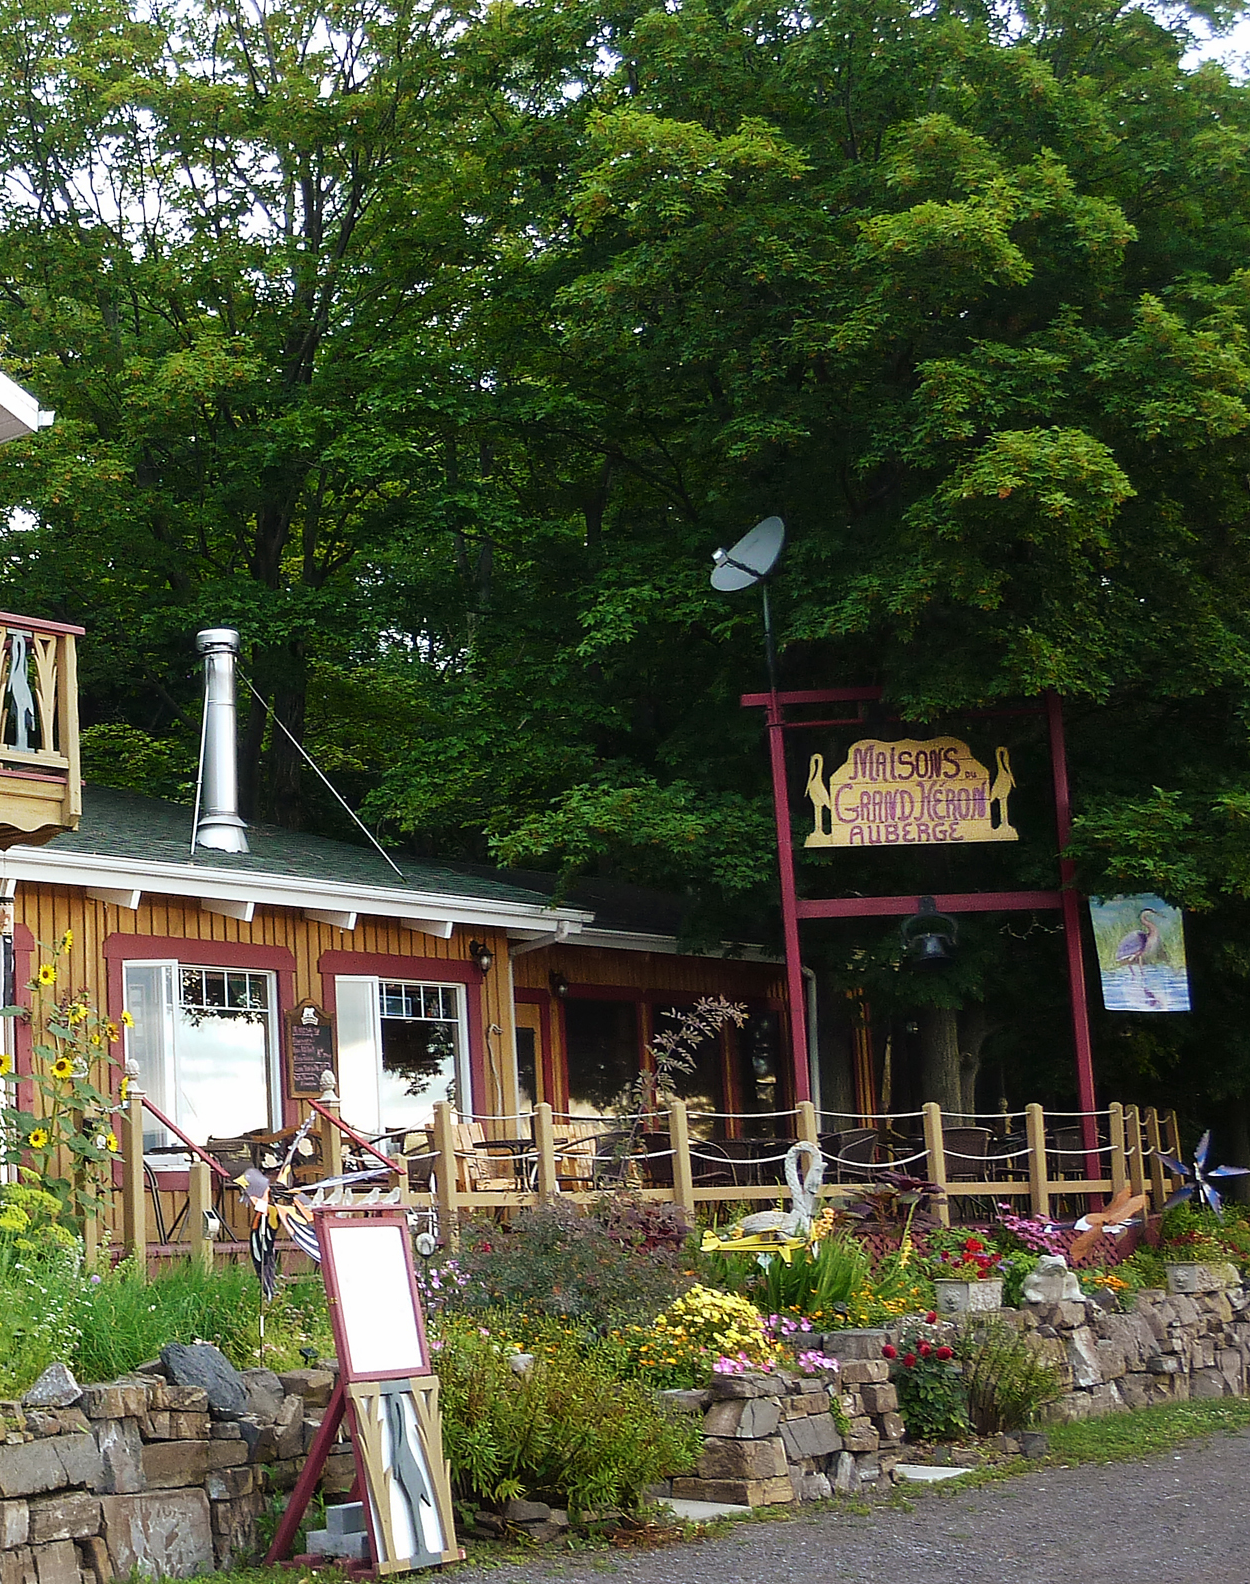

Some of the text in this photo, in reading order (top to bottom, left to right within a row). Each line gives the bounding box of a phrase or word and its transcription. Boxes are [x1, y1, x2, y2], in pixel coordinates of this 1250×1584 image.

[849, 745, 960, 781] MAISONS
[834, 783, 914, 823] GRAND
[849, 822, 964, 844] AUBERGE
